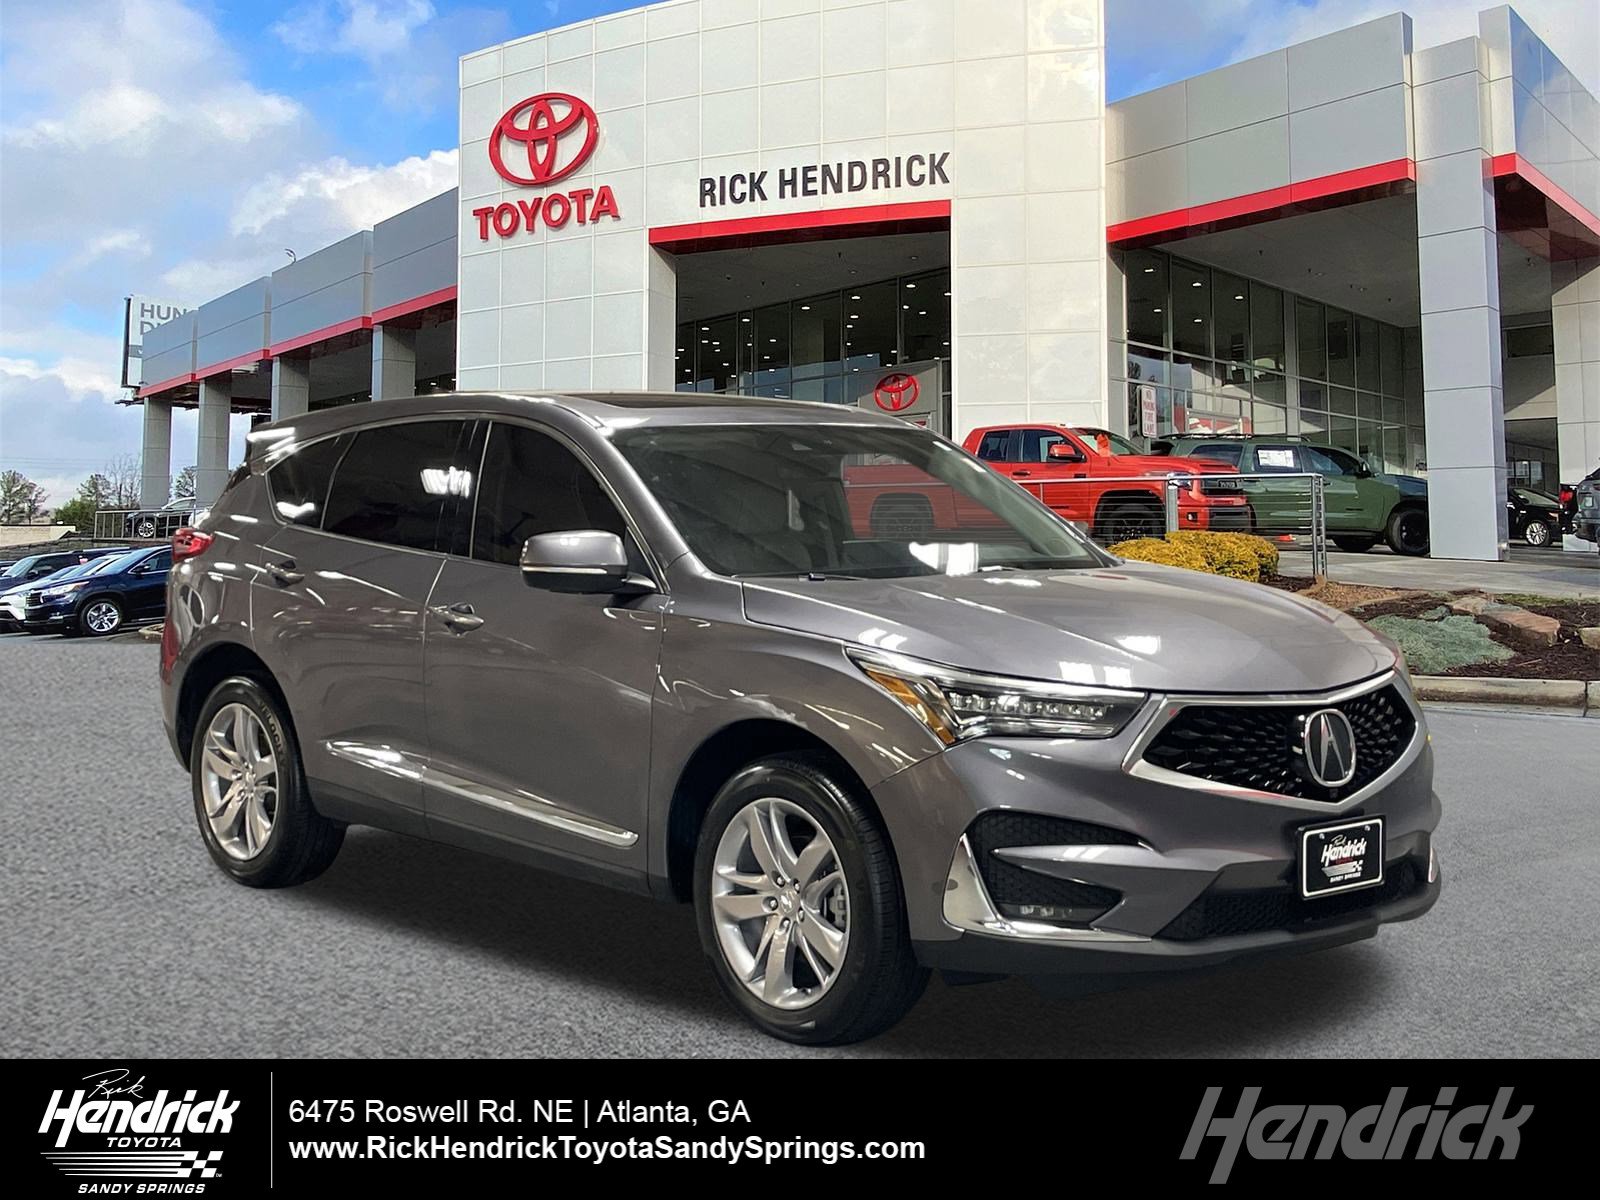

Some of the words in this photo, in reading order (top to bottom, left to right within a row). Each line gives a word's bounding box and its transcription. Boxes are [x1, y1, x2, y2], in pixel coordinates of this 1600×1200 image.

[699, 170, 768, 208] RICK
[778, 152, 950, 200] HENDRICK
[472, 184, 621, 241] TOYOTA
